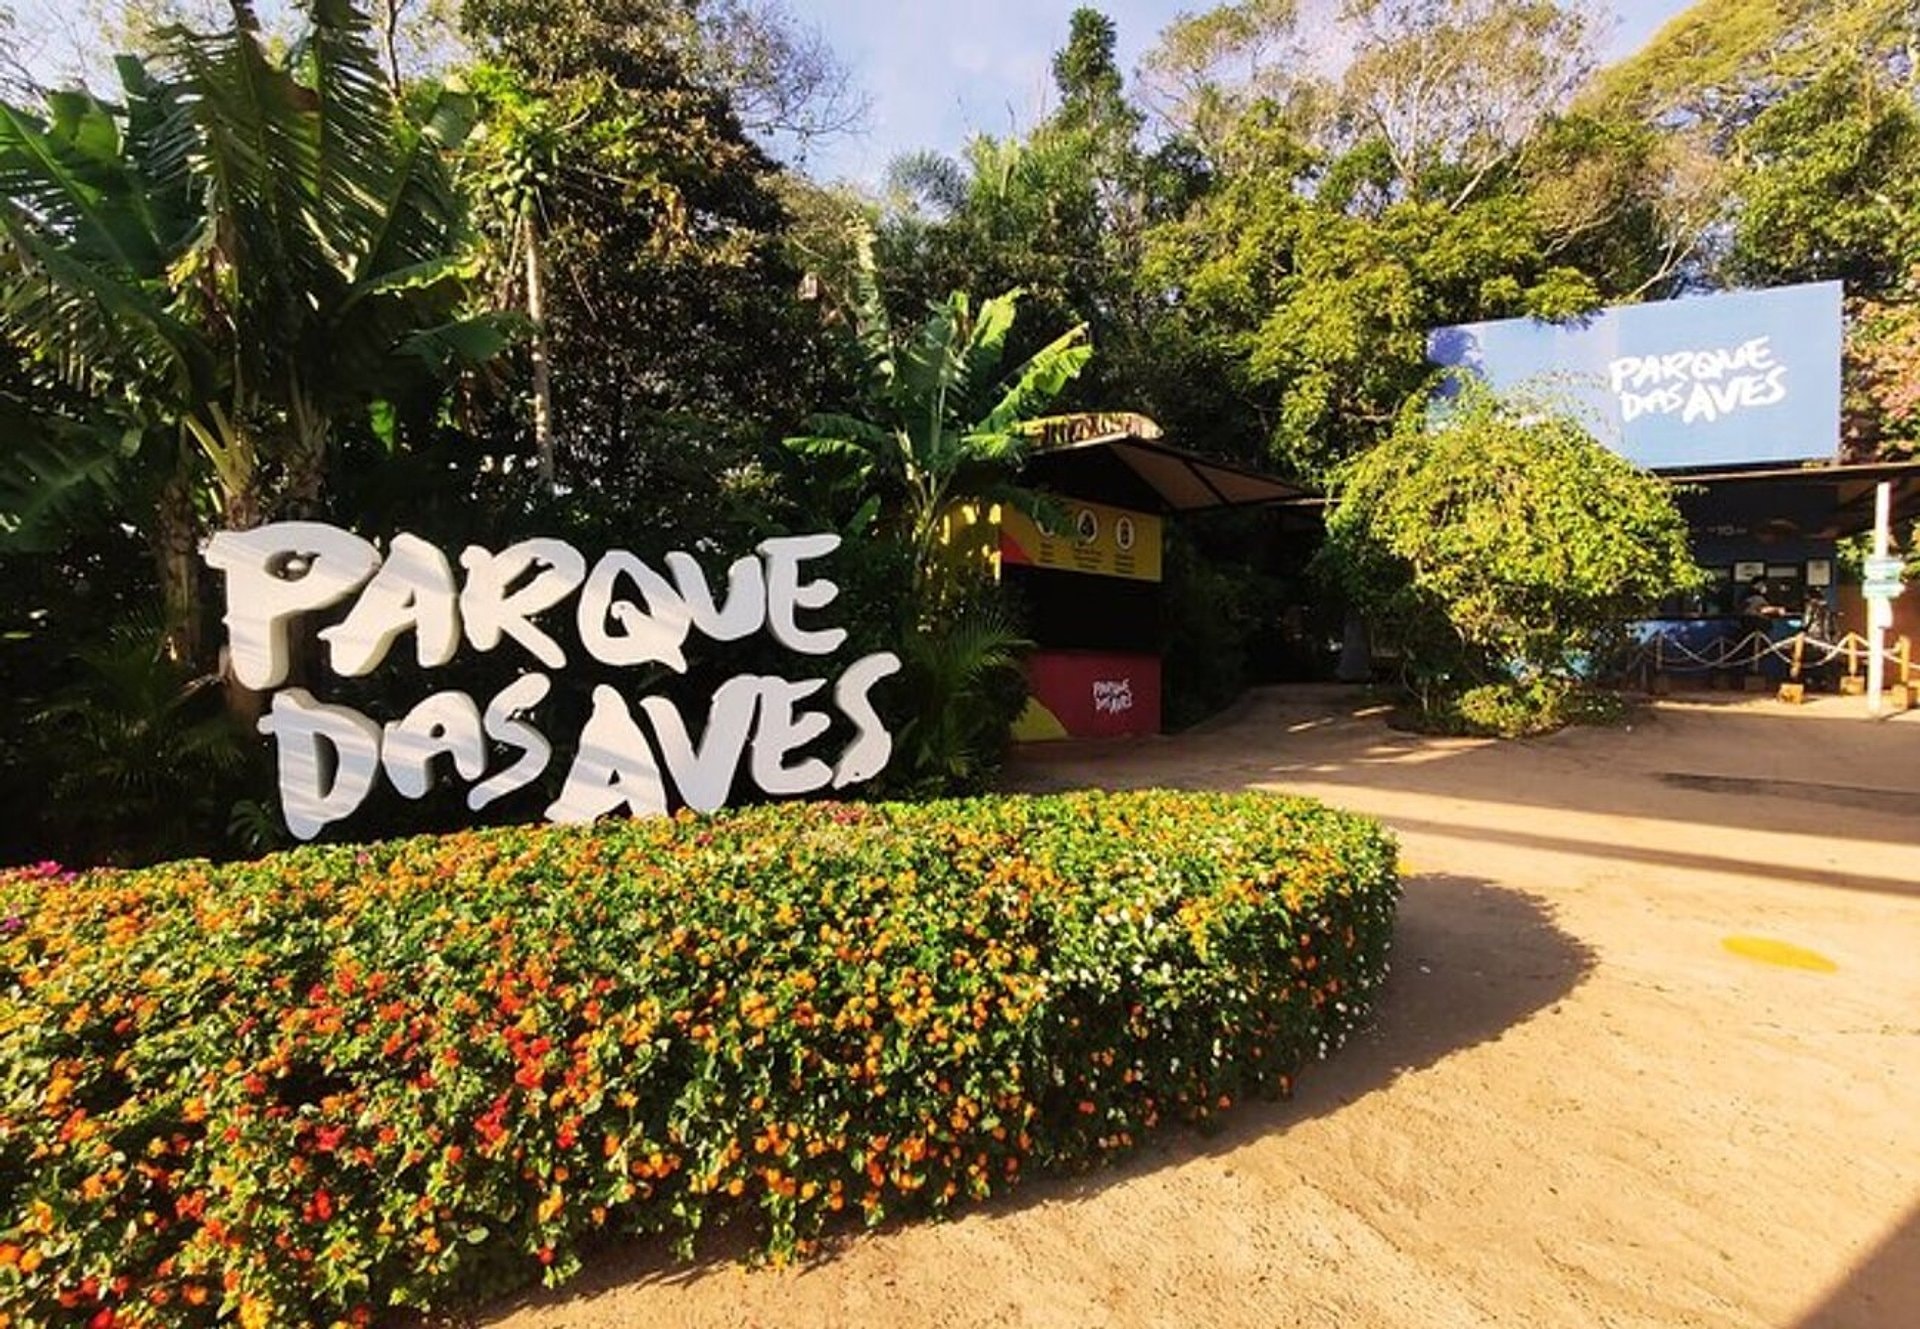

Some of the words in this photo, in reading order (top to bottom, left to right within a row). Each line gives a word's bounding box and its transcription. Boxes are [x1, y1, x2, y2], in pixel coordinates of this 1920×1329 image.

[1609, 335, 1776, 393] PARQUE
[1619, 382, 1684, 423] DAS
[1682, 366, 1788, 424] AVES
[203, 521, 848, 690] PARQUE
[258, 672, 552, 840] DAS
[543, 651, 902, 824] AVES
